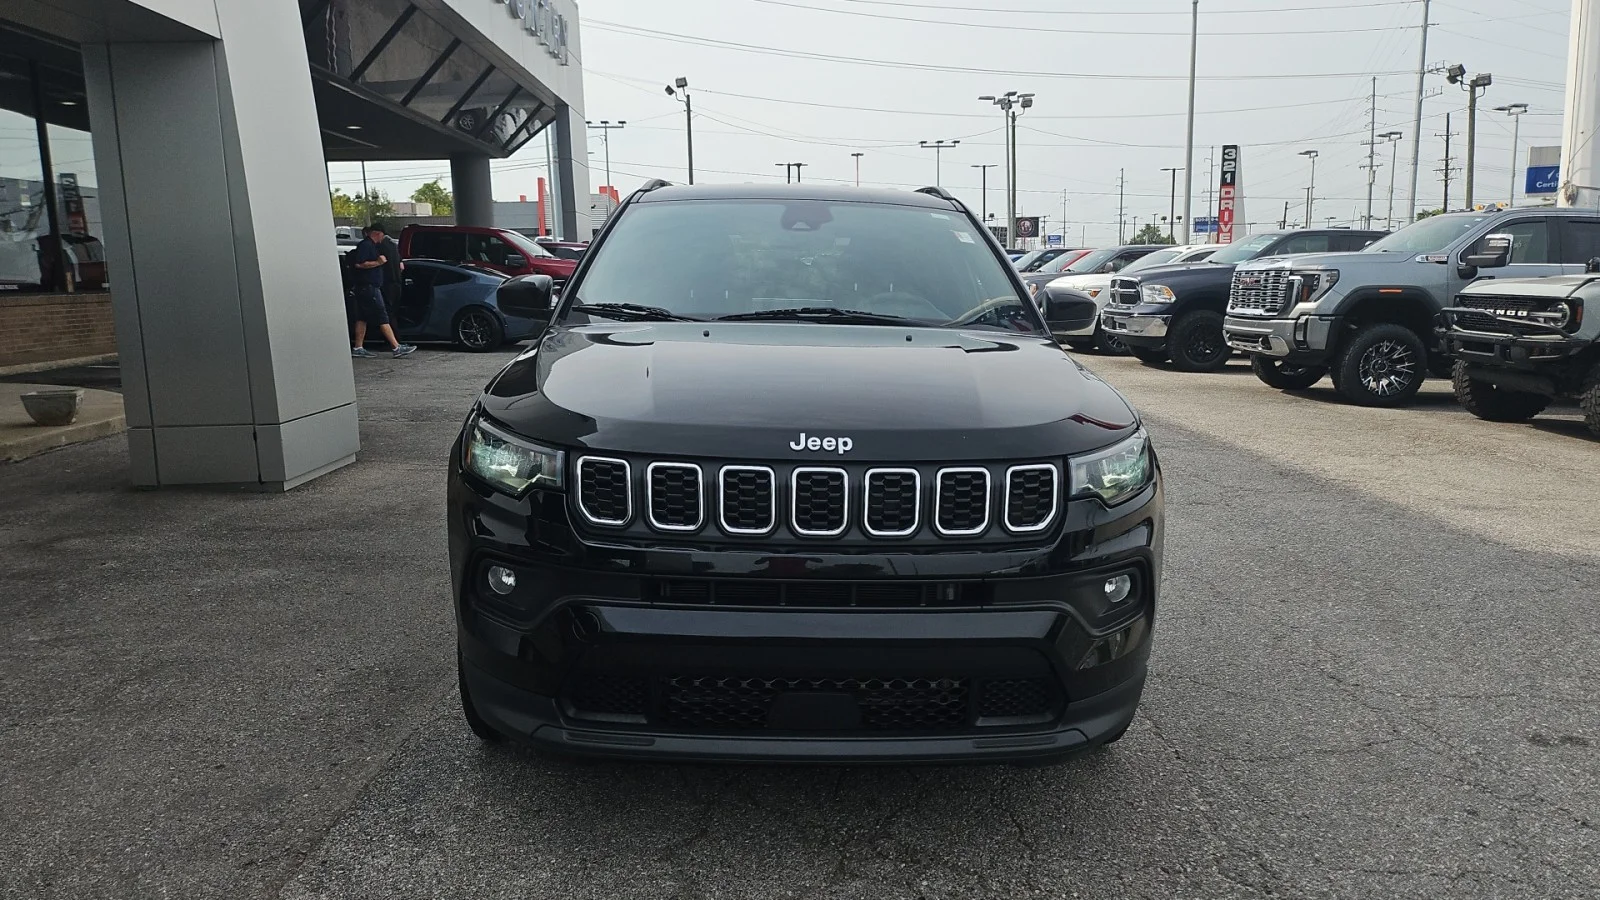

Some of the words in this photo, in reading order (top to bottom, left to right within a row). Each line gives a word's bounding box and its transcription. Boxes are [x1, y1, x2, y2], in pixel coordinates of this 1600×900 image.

[1223, 148, 1237, 183] 321
[1219, 187, 1235, 243] DRIVE
[789, 432, 853, 455] Jeep
